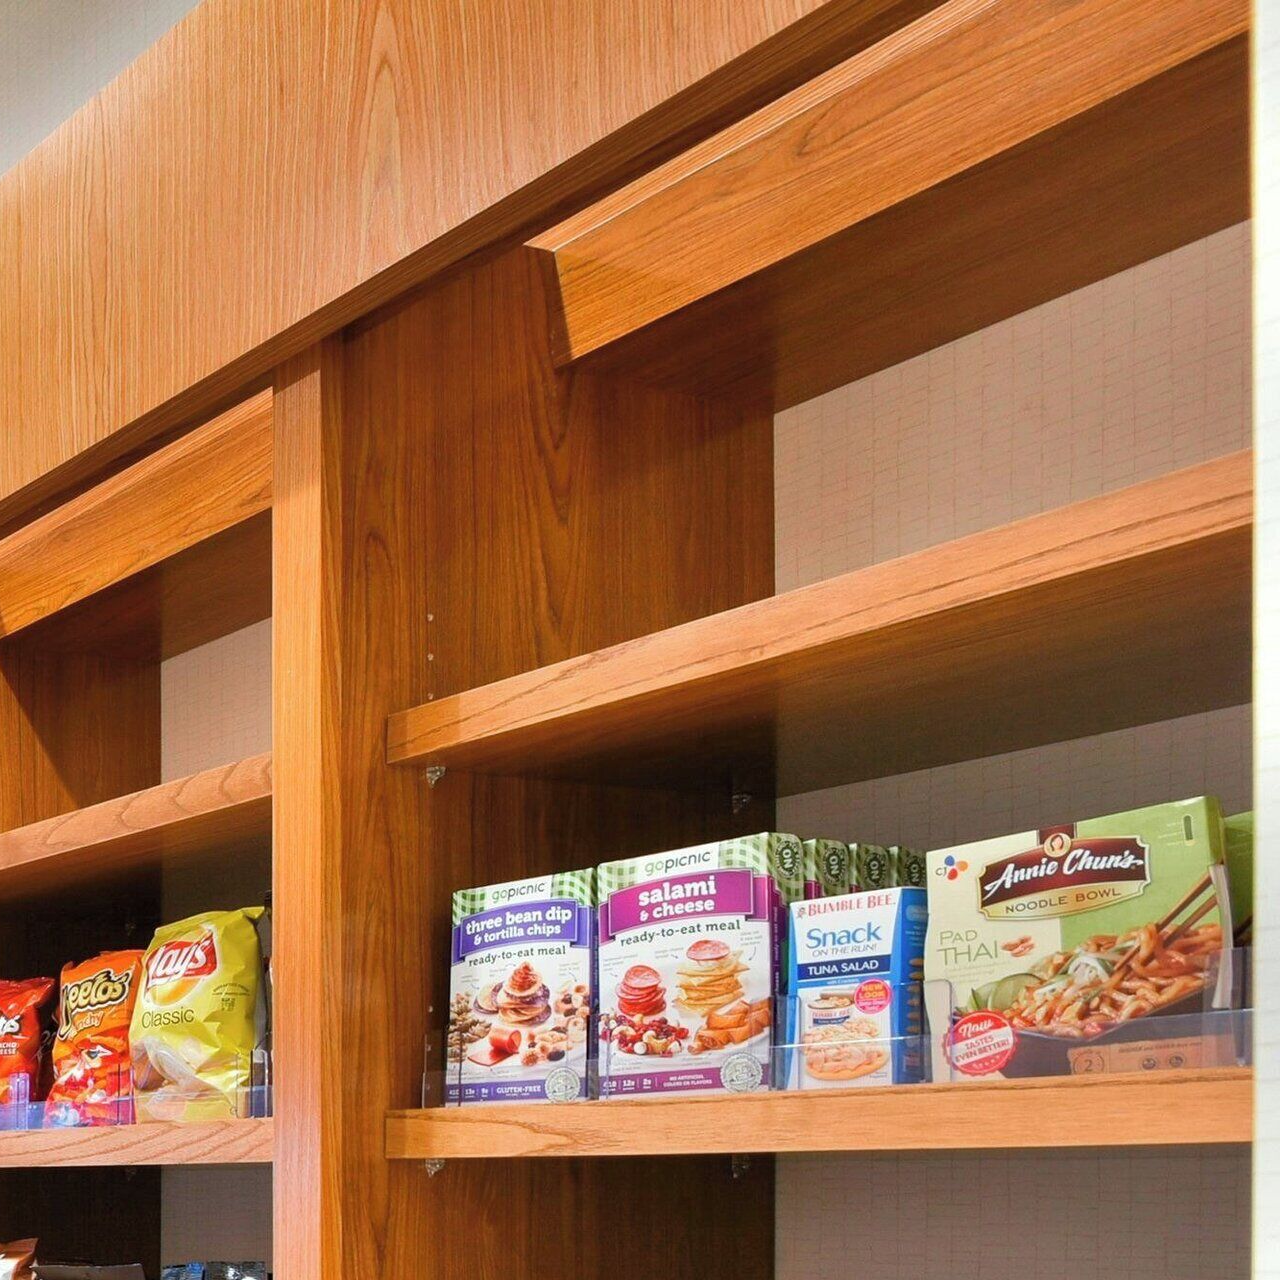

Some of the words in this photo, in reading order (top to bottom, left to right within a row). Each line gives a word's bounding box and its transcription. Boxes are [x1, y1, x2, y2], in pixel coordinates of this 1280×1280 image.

[645, 851, 711, 876] gopicnic
[984, 858, 1058, 900] Annie
[1062, 849, 1144, 876] Chun's
[492, 882, 545, 903] gopicnic
[638, 875, 717, 907] salami
[1005, 895, 1068, 914] NOODLE
[1076, 887, 1122, 902] BOWL
[640, 910, 649, 922] &
[652, 898, 715, 918] cheese
[808, 896, 863, 917] BUMBLE
[466, 918, 502, 935] three
[506, 910, 542, 925] bean
[545, 906, 572, 924] dip
[474, 934, 484, 945] &
[484, 927, 525, 942] tortilla
[527, 923, 561, 937] chips
[620, 924, 701, 947] ready-to-eat
[705, 920, 741, 933] meal
[806, 922, 882, 949] Snack
[939, 929, 978, 945] PAD
[147, 935, 216, 989] Lay's
[468, 947, 533, 967] ready-to-eat
[538, 945, 566, 956] meal
[812, 948, 829, 958] ON
[831, 945, 850, 956] THE
[937, 940, 998, 966] THAI
[808, 963, 840, 976] TUNA
[841, 960, 879, 974] SALAD
[863, 982, 882, 992] NEW
[141, 1006, 195, 1029] Classic
